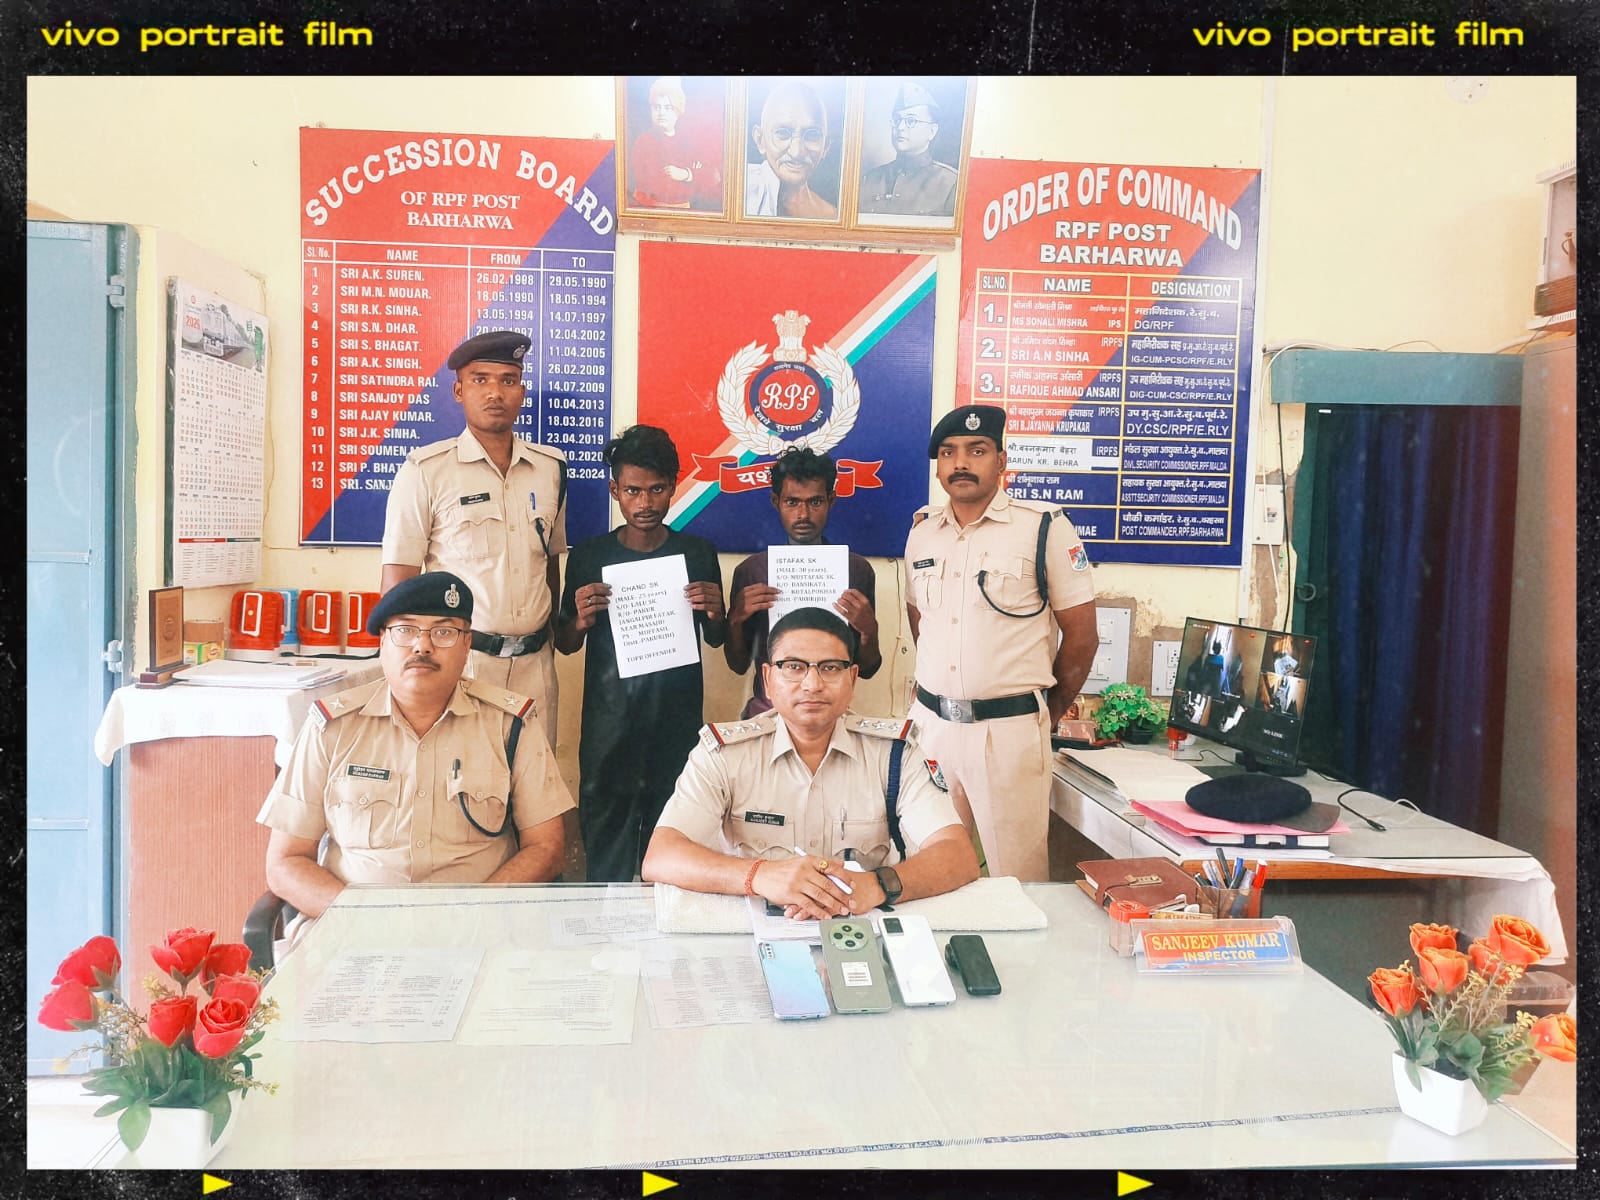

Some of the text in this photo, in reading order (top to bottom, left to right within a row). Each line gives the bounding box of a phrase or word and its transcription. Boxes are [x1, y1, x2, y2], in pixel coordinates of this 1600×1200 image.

[305, 138, 614, 236] SUCCESSION BOARD
[400, 191, 521, 210] OF RPF POST
[982, 167, 1242, 250] ORDER OF COMMAND
[406, 212, 514, 230] BARHARWA
[1055, 221, 1172, 242] RPF POST
[386, 249, 419, 261] NAME
[490, 253, 521, 265] FROM
[1040, 244, 1184, 268] BARHARWA
[571, 256, 586, 268] TO
[312, 267, 318, 277] 1
[341, 268, 425, 281] SRI A.K. SUREN.
[549, 276, 606, 288] 29.05.1990
[1043, 277, 1092, 292] NAME
[312, 285, 318, 296] 2
[340, 285, 358, 296] SRI
[361, 286, 386, 298] M.N.
[1151, 281, 1231, 297] DESIGNATION
[477, 291, 534, 303] 18.05.1990
[312, 303, 318, 313] 3
[340, 303, 422, 317] SRI R.K. SINHA.
[983, 302, 1005, 323] 1.
[550, 311, 606, 323] 14.07.1997
[1025, 317, 1056, 327] SONALI
[1057, 317, 1088, 328] MISHRA
[311, 320, 318, 330] 4
[340, 321, 419, 334] SRI S.N. DHAR.
[1108, 319, 1122, 328] IPS
[1134, 320, 1175, 330] DG/RPF
[549, 328, 606, 341] 12.04.2002
[312, 338, 318, 348] 5
[340, 339, 422, 351] SRI S. BHAGAT.
[980, 337, 1002, 358] 2.
[1101, 337, 1123, 347] IRPFS
[549, 346, 606, 358] 11.04.2005
[1011, 350, 1090, 362] SRI A.N SINHA
[311, 356, 318, 366] 6
[340, 356, 422, 369] SRI A.K. SINGH.
[1131, 355, 1234, 366] IG-CUM-PCSC/RPF/E.RLY
[311, 373, 318, 384] 7
[340, 374, 358, 385] SRI
[360, 374, 415, 387] SATINDRA
[979, 373, 1001, 393] 3.
[1099, 372, 1122, 383] IRPFS
[548, 381, 605, 393] 14.07.2009
[1009, 385, 1120, 398] RAFIQUE AHMAD ANSARI
[311, 391, 318, 402] 8
[340, 391, 430, 405] SRI SANJOY DAS
[1130, 390, 1232, 401] DIG-CUM-CSC/RPF/E.RLY
[548, 398, 605, 410] 10.04.2013
[311, 408, 318, 419] 9
[339, 409, 435, 422] SRI AJAY KUMAR.
[1098, 407, 1120, 417] IRPFS
[547, 415, 604, 428] 18.03.2016
[1008, 420, 1019, 431] SRI
[1056, 422, 1091, 432] KRUPAKAR
[311, 426, 325, 437] 10
[339, 427, 420, 439] SRI J.K. SINHA.
[1126, 423, 1229, 436] DY.CSC/RPF/E.RLY
[547, 432, 604, 445] 23.04.2019
[311, 444, 324, 454] 11
[339, 444, 357, 455] SRI
[360, 445, 407, 457] SOUMEN
[1096, 446, 1118, 456] IRPFS
[311, 461, 324, 472] 12
[339, 462, 371, 473] SRI P.
[1007, 457, 1033, 465] BARUN
[1053, 459, 1079, 467] BEHRA
[311, 477, 324, 489] 13
[340, 478, 362, 490] SRI.
[1006, 488, 1084, 500] SRI S.N RAM
[1121, 526, 1138, 536] POST
[621, 583, 646, 593] CHAND
[1151, 932, 1282, 950] SANJEEV KUMAR
[1183, 950, 1257, 961] INSPECTOR
